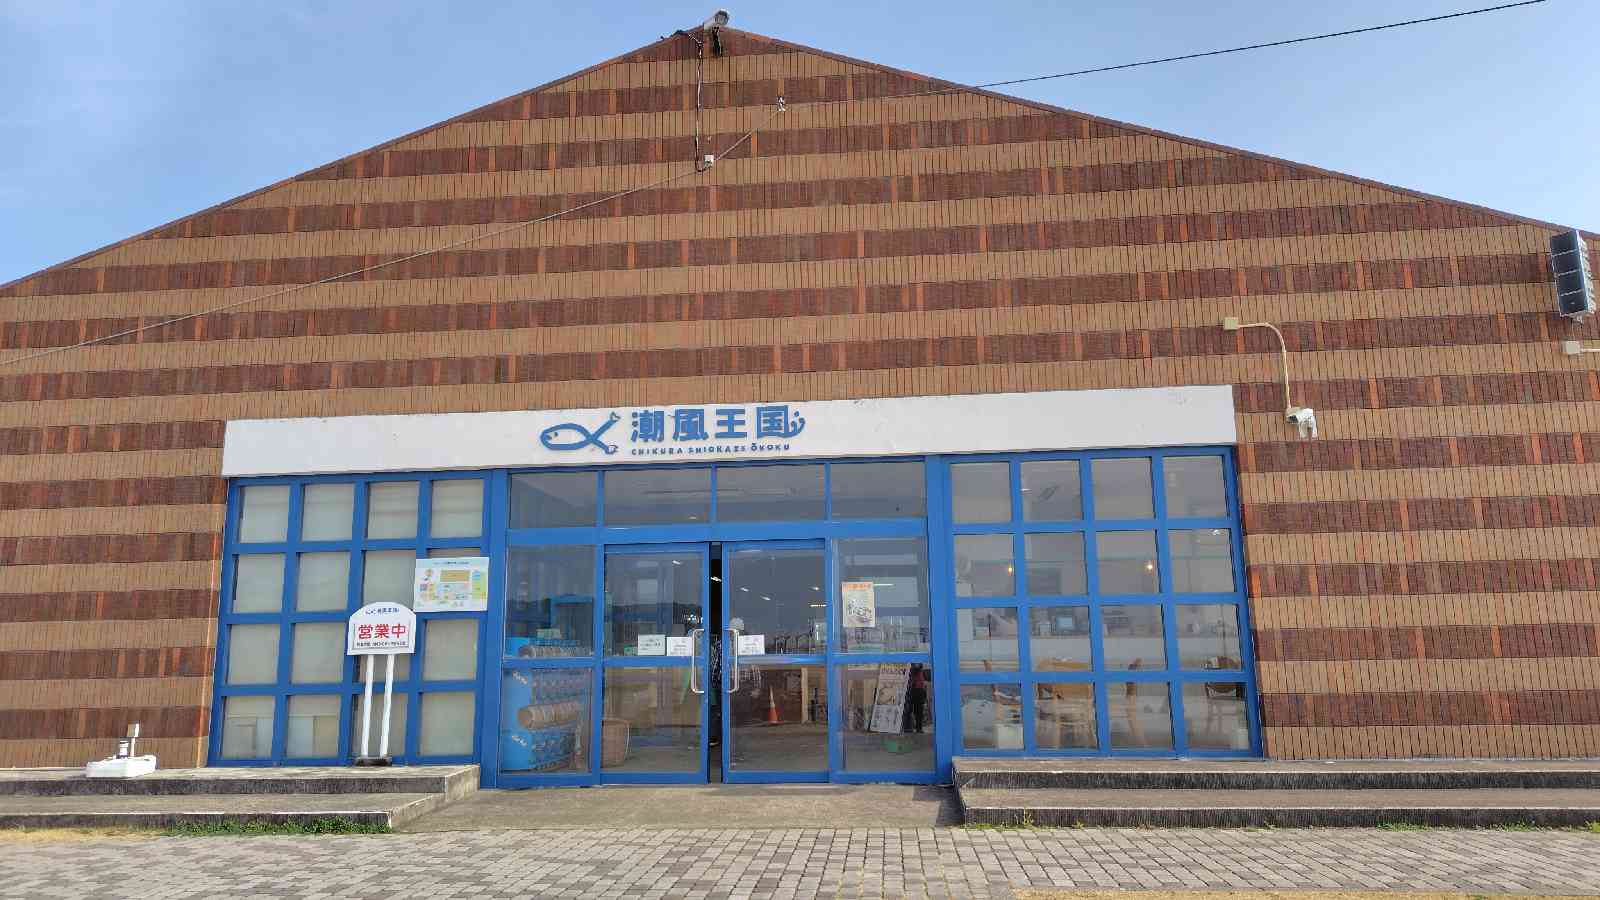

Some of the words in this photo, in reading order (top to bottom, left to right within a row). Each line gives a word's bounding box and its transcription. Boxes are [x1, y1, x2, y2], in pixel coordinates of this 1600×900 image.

[631, 405, 804, 442] 潮風王国
[631, 446, 683, 456] CHIKURA
[358, 623, 406, 639] 営業中
